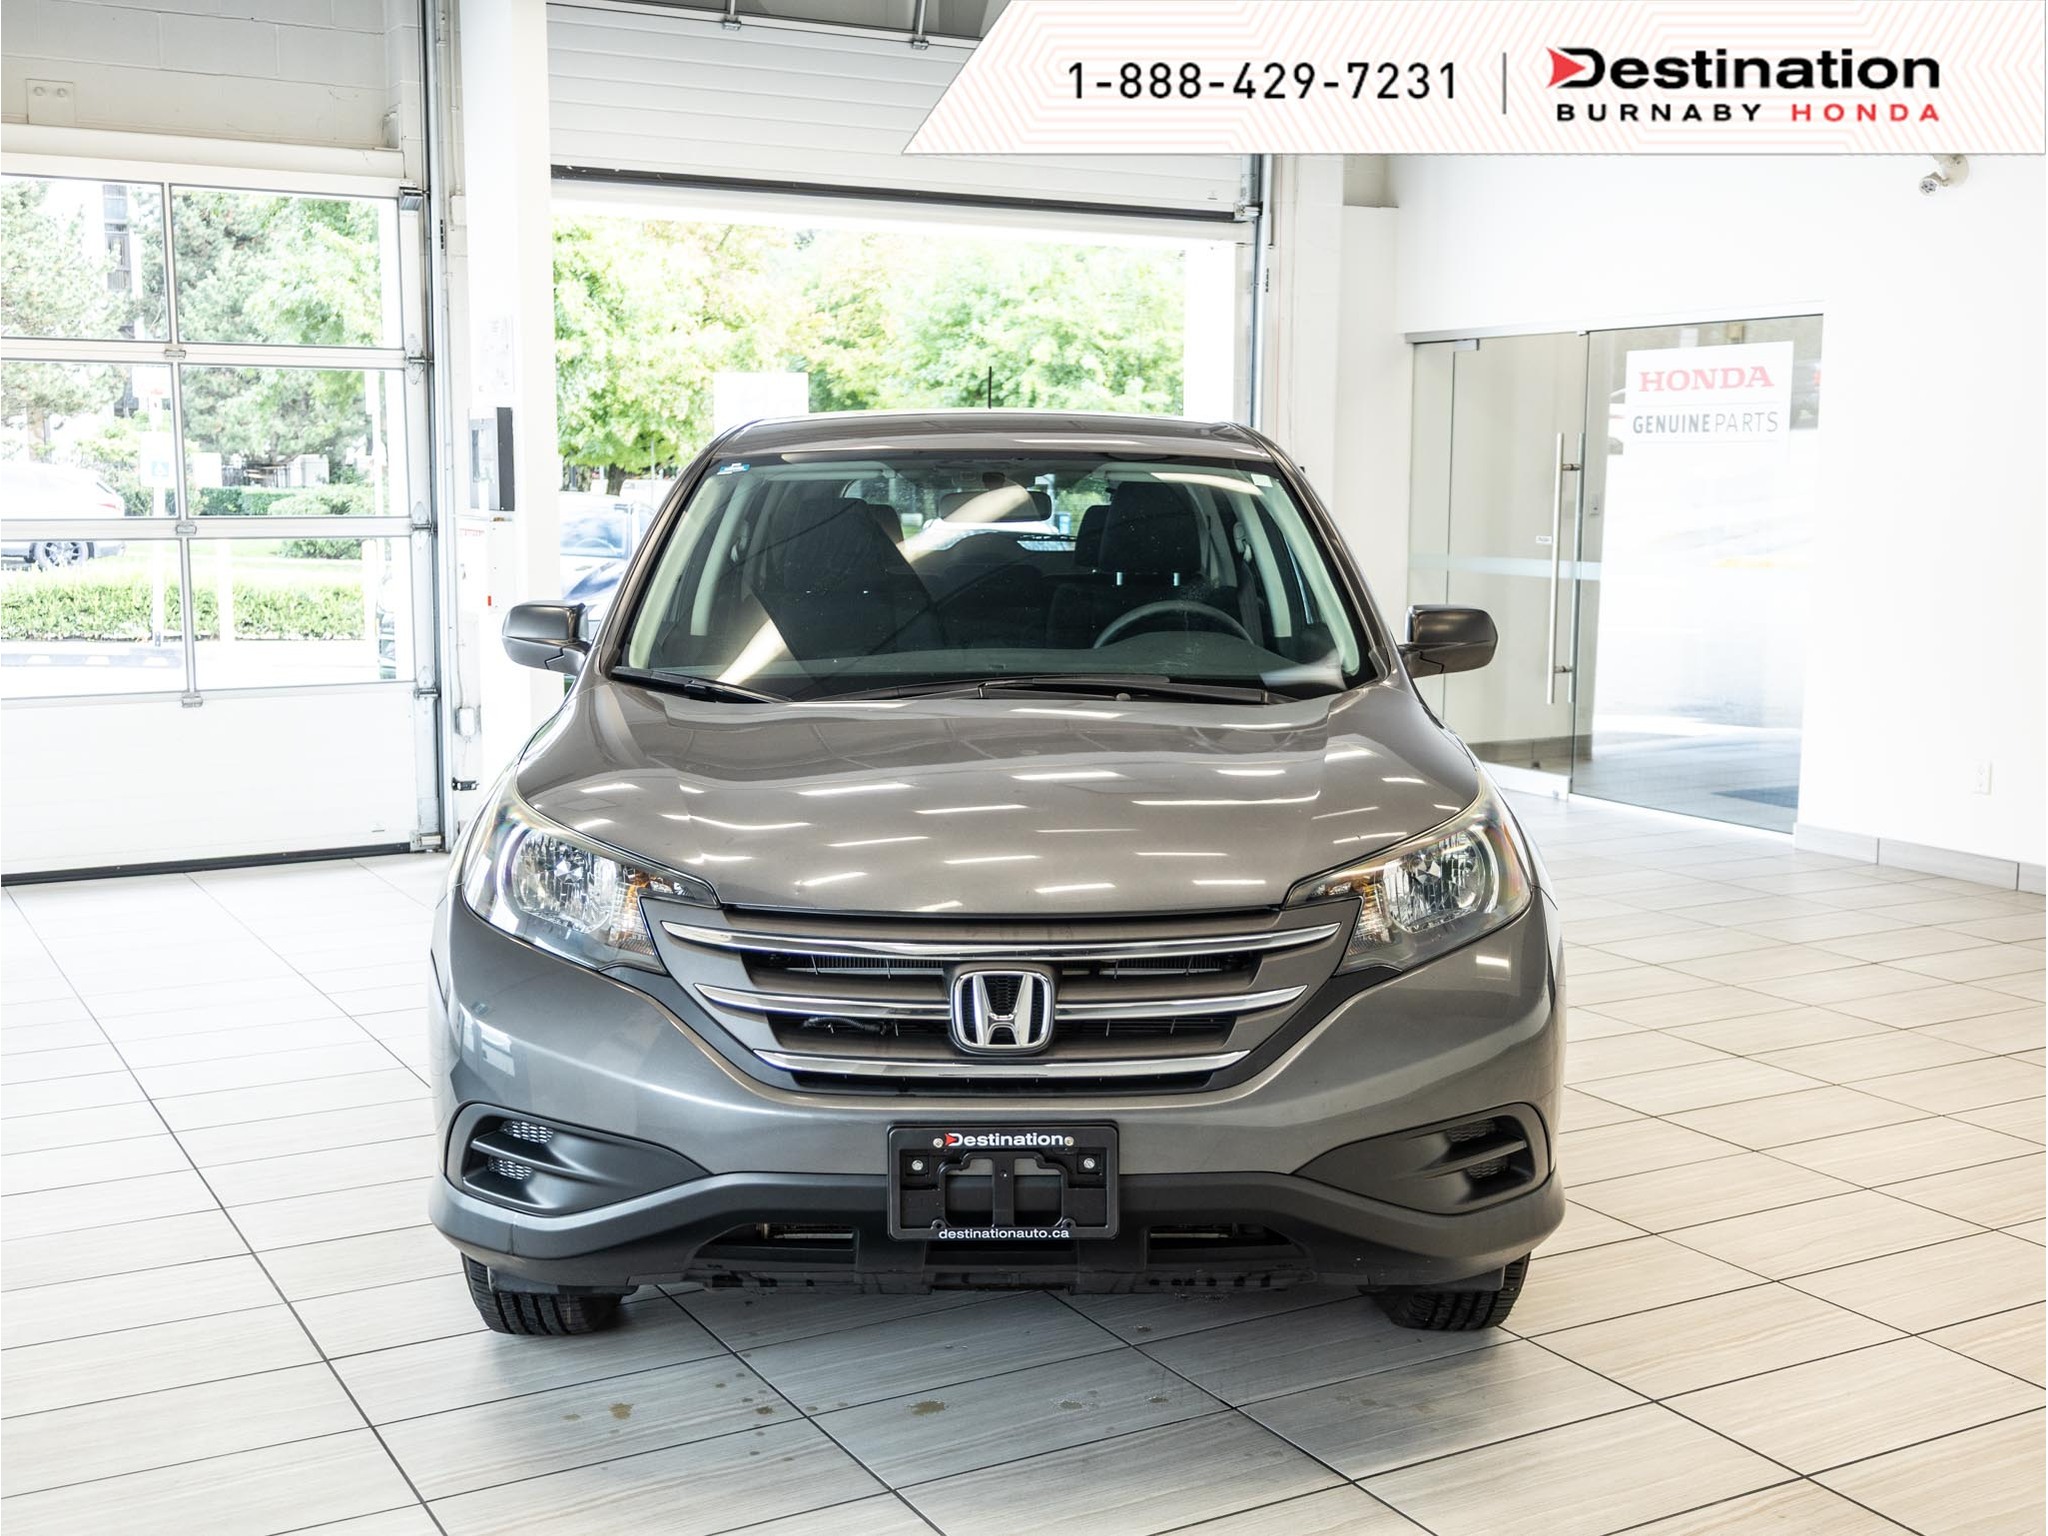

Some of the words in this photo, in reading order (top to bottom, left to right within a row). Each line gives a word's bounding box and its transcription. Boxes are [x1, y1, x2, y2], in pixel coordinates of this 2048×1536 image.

[1638, 366, 1775, 393] HONDA
[945, 1132, 1064, 1147] Destination
[938, 1228, 1070, 1240] destinationauto.ca
